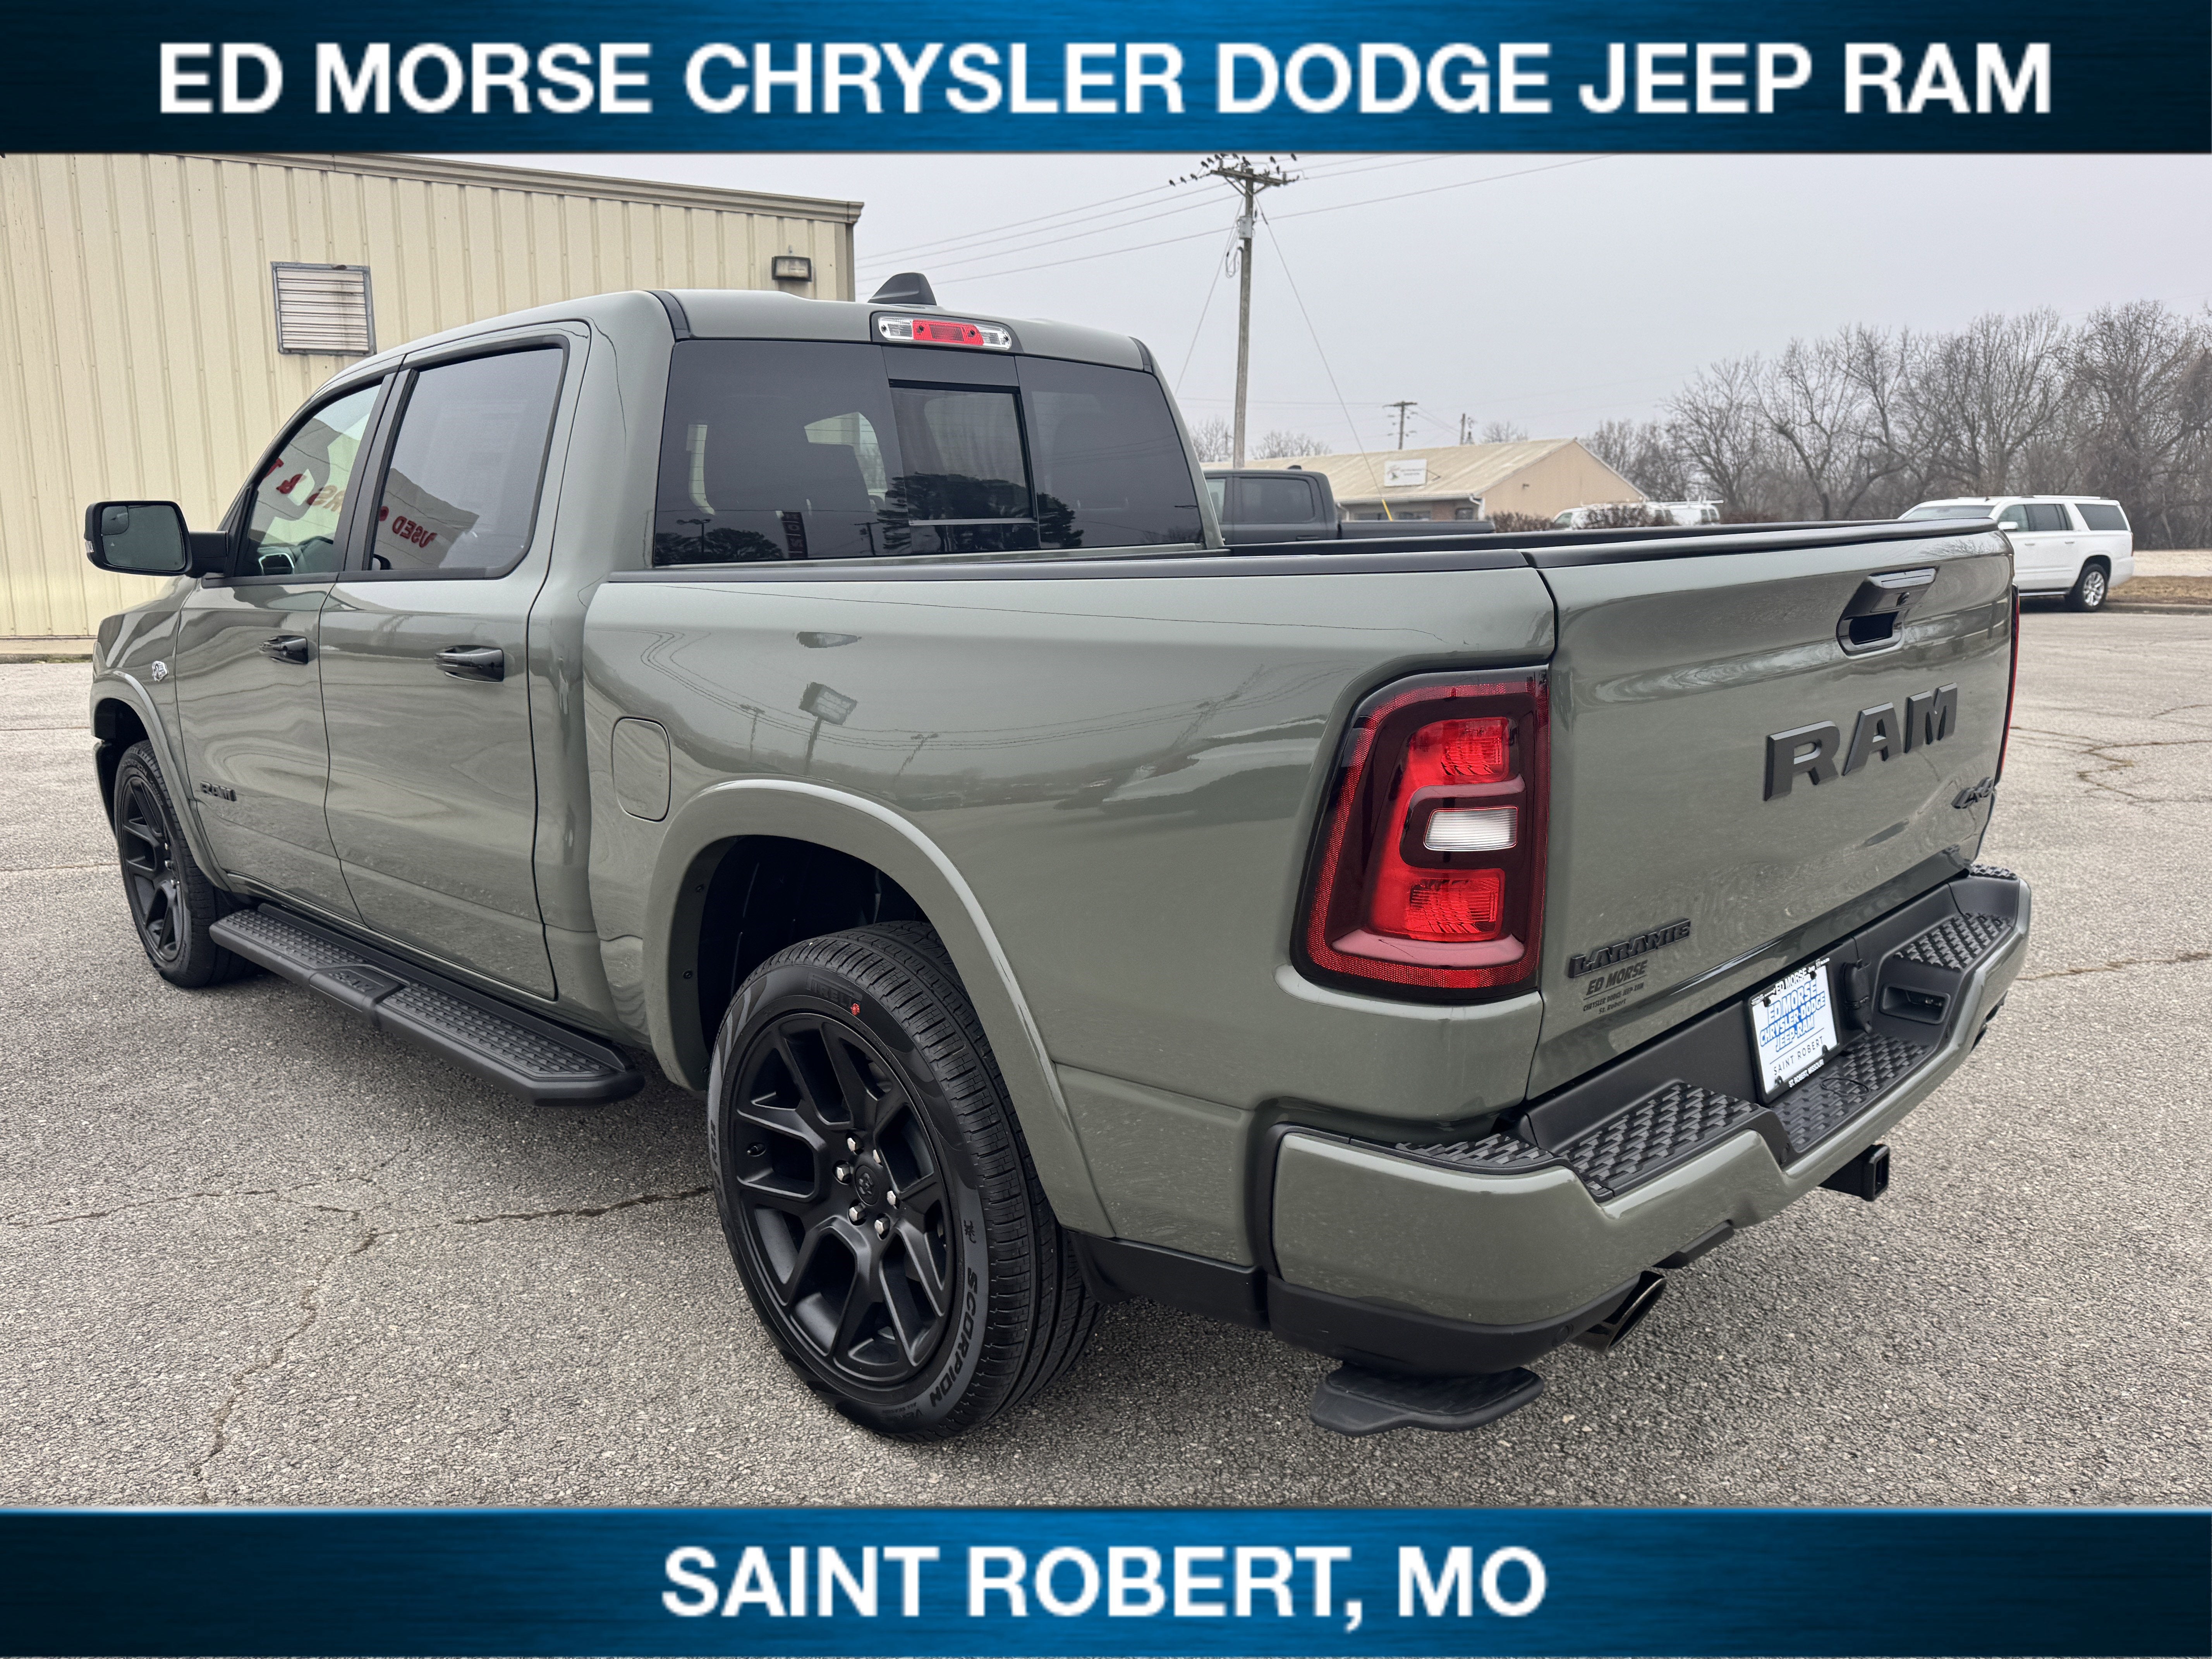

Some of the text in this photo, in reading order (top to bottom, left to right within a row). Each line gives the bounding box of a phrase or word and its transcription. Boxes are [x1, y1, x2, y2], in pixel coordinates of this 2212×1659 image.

[1763, 682, 1958, 802] RAM
[200, 781, 237, 802] RAM
[1568, 918, 1691, 979] LARAMIE
[1586, 960, 1648, 996] ED MORSE
[1775, 981, 1785, 995] ED
[1785, 967, 1807, 988] MORSE
[1767, 979, 1817, 1026] ED MORSE
[1774, 1036, 1822, 1075] SAINT ROBERT
[930, 1267, 978, 1407] SCORPION
